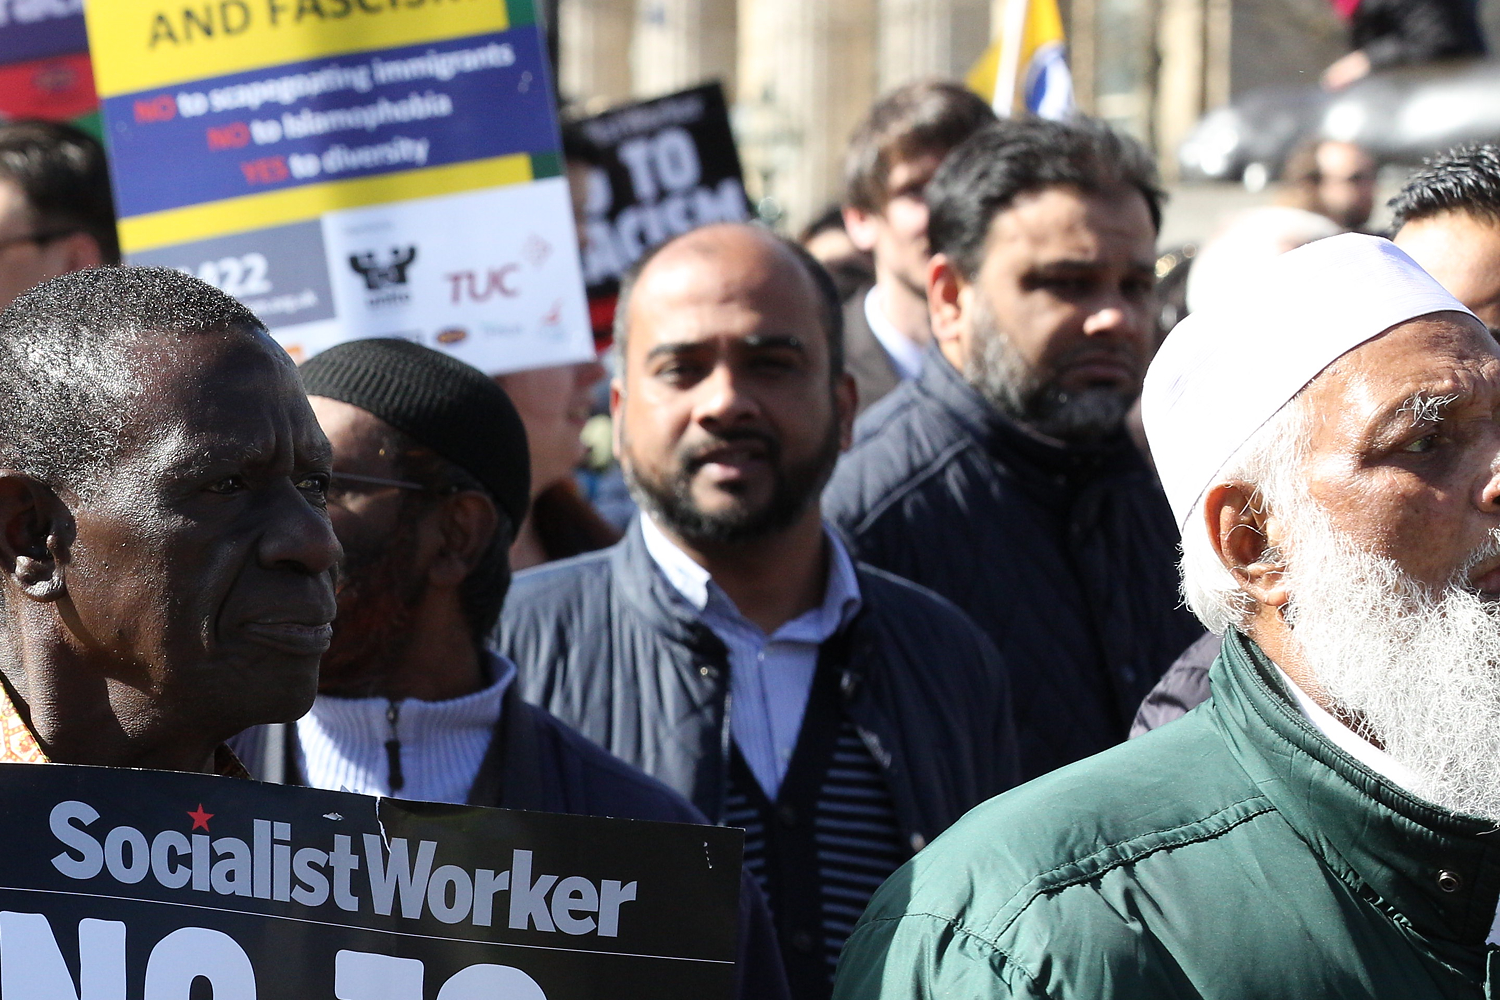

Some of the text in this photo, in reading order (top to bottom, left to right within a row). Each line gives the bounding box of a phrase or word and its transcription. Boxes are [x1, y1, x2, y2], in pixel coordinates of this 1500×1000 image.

[147, 0, 253, 49] AND
[132, 93, 178, 124] NO
[177, 91, 209, 118] to
[371, 42, 516, 86] immigrants
[205, 88, 454, 151] NO to Islamophobia
[239, 134, 431, 186] YES to diversity
[617, 125, 702, 201] TO
[444, 262, 521, 305] TUC
